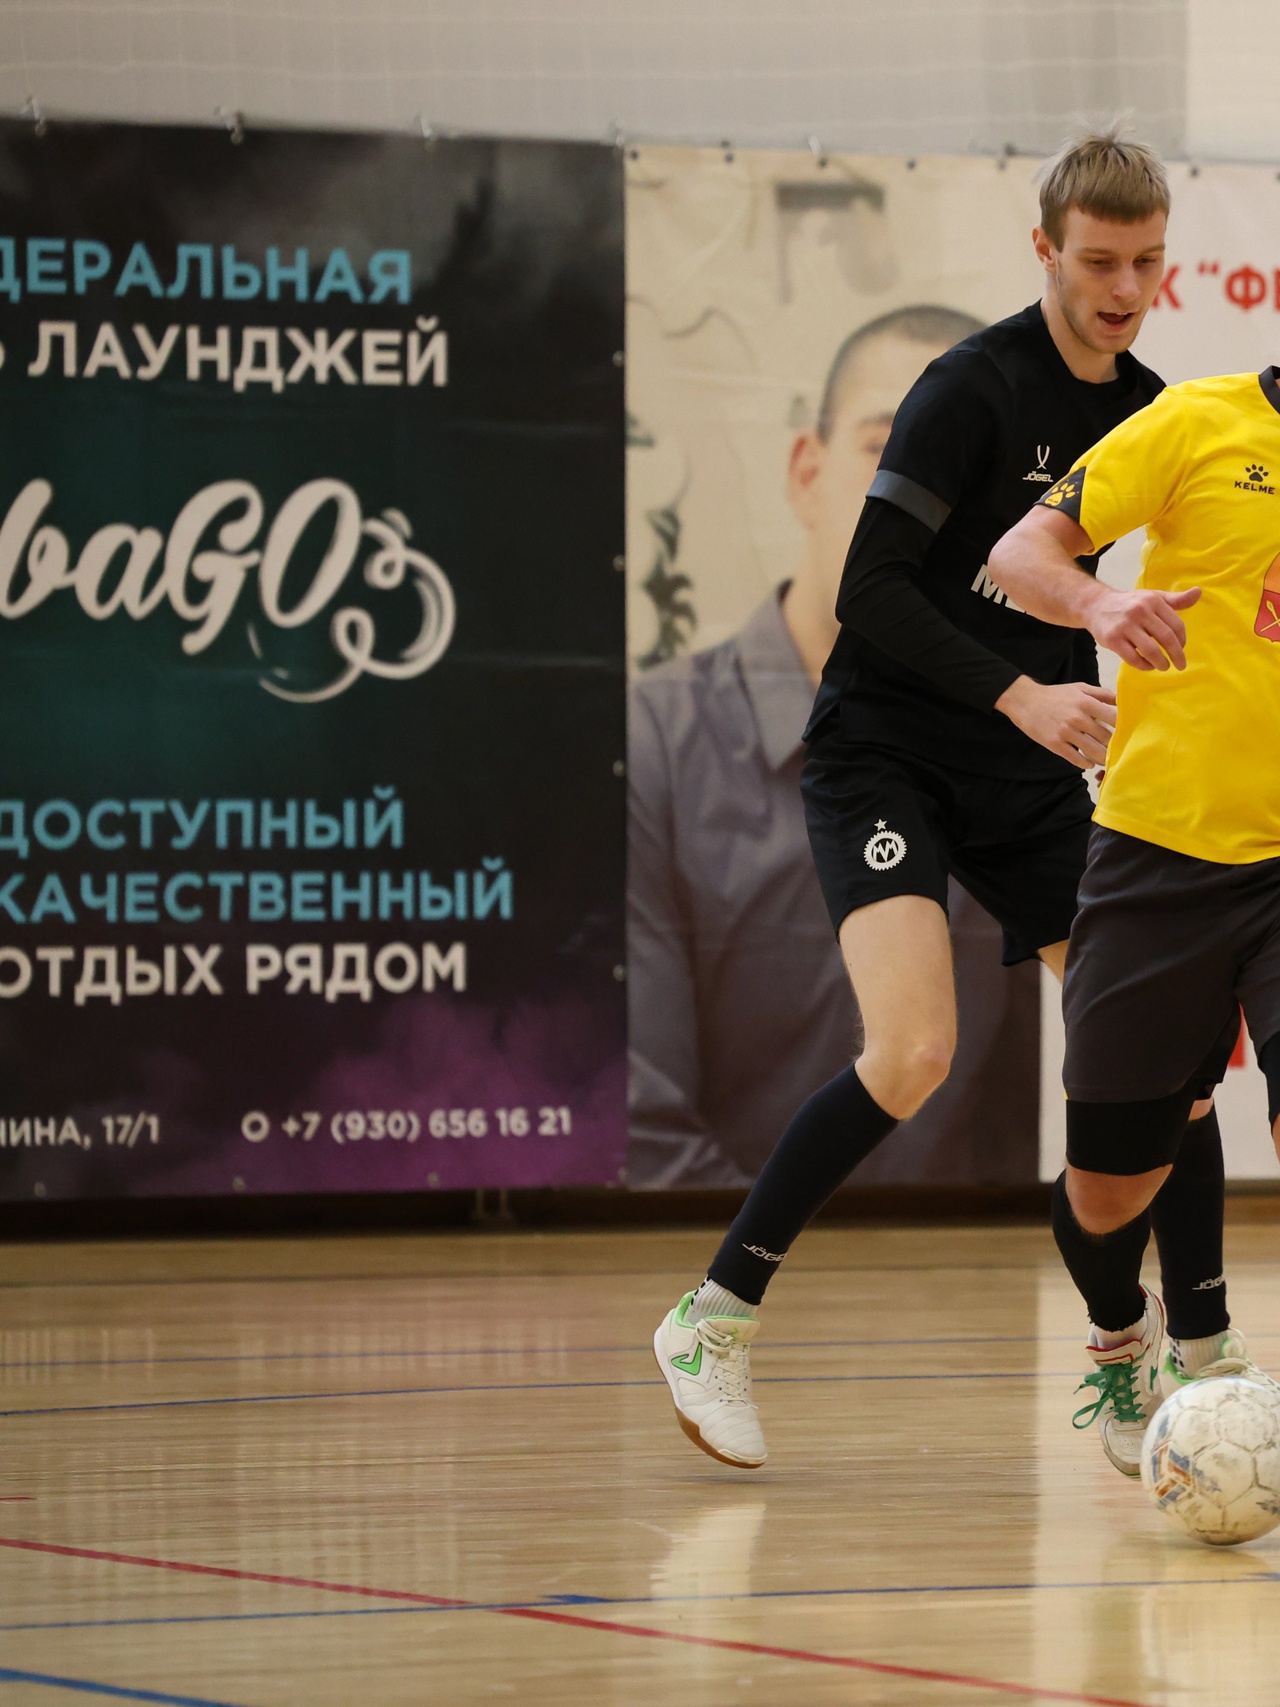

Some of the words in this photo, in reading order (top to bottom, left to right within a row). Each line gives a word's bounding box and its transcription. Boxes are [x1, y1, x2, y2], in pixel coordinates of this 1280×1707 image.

[28, 316, 448, 393] ЛАУНДЖЕЙ
[1234, 480, 1276, 495] KELME
[0, 784, 404, 859] ДОСТУПНЫЙ
[0, 856, 514, 924] КАЧЕСТВЕННЫЙ
[0, 944, 223, 1006] ОТДЫХ
[244, 942, 467, 1003] РЯДОМ
[0, 1115, 92, 1150] ИНА,
[101, 1110, 160, 1149] 17/1
[281, 1111, 322, 1142] +7
[330, 1110, 421, 1145] (930)
[428, 1108, 488, 1139] 656
[495, 1107, 530, 1138] 16
[537, 1106, 572, 1136] 21
[742, 1242, 788, 1262] JÖGE
[1191, 1274, 1225, 1290] JÖG
